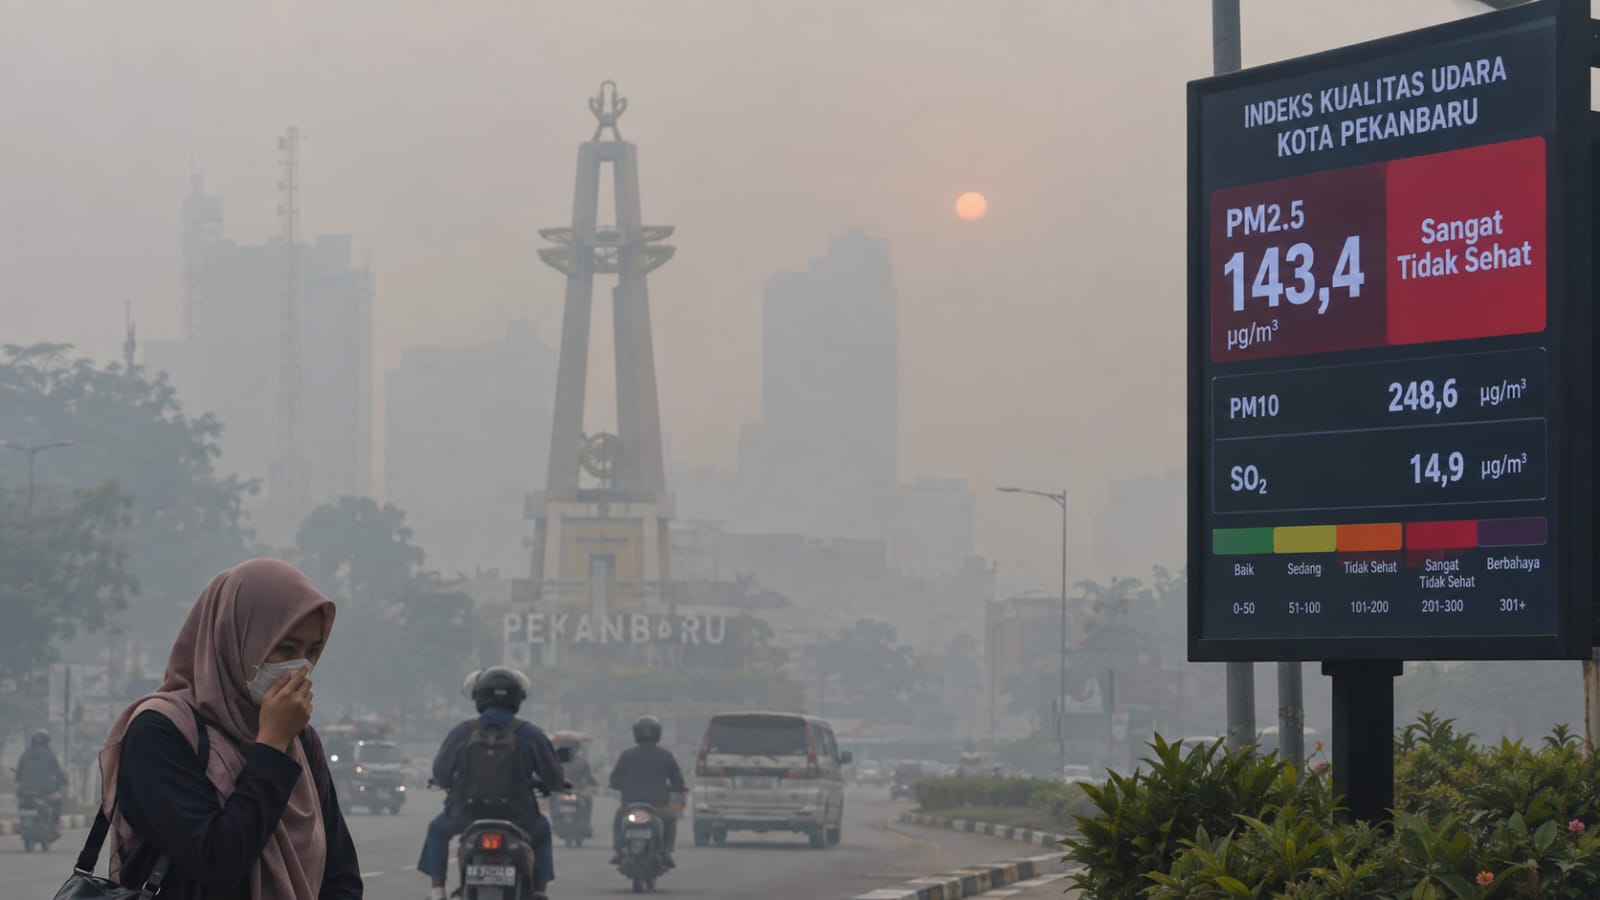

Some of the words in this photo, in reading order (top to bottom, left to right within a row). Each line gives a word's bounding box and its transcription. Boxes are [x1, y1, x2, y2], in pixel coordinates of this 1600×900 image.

[1244, 93, 1314, 128] INDEKS
[1320, 70, 1425, 113] KUALITAS
[1432, 56, 1507, 92] UDARA
[1277, 127, 1334, 157] KOTA
[1340, 98, 1478, 147] PEKANBARU
[1226, 200, 1305, 237] PM2.5
[1421, 210, 1504, 245] Sangat
[1397, 253, 1459, 280] Tidak
[1465, 241, 1532, 273] Sehat
[1224, 235, 1365, 315] 143,4
[1230, 394, 1280, 419] PM10
[1388, 378, 1458, 415] 248,6
[1410, 451, 1464, 487] 14,9
[1234, 562, 1255, 576] Baik
[1287, 562, 1322, 577] Sedang
[1343, 560, 1368, 574] Tidak
[1370, 560, 1398, 574] Sehat
[1425, 559, 1460, 574] Sangat
[1486, 556, 1540, 573] Berbahaya
[1419, 574, 1446, 588] Tidak
[1447, 573, 1476, 588] Sehat
[1233, 602, 1255, 615] 0-50
[1288, 601, 1321, 614] 51-100
[1350, 601, 1389, 614] 101-200
[1421, 599, 1464, 613] 201-300
[1499, 598, 1526, 612] 301+
